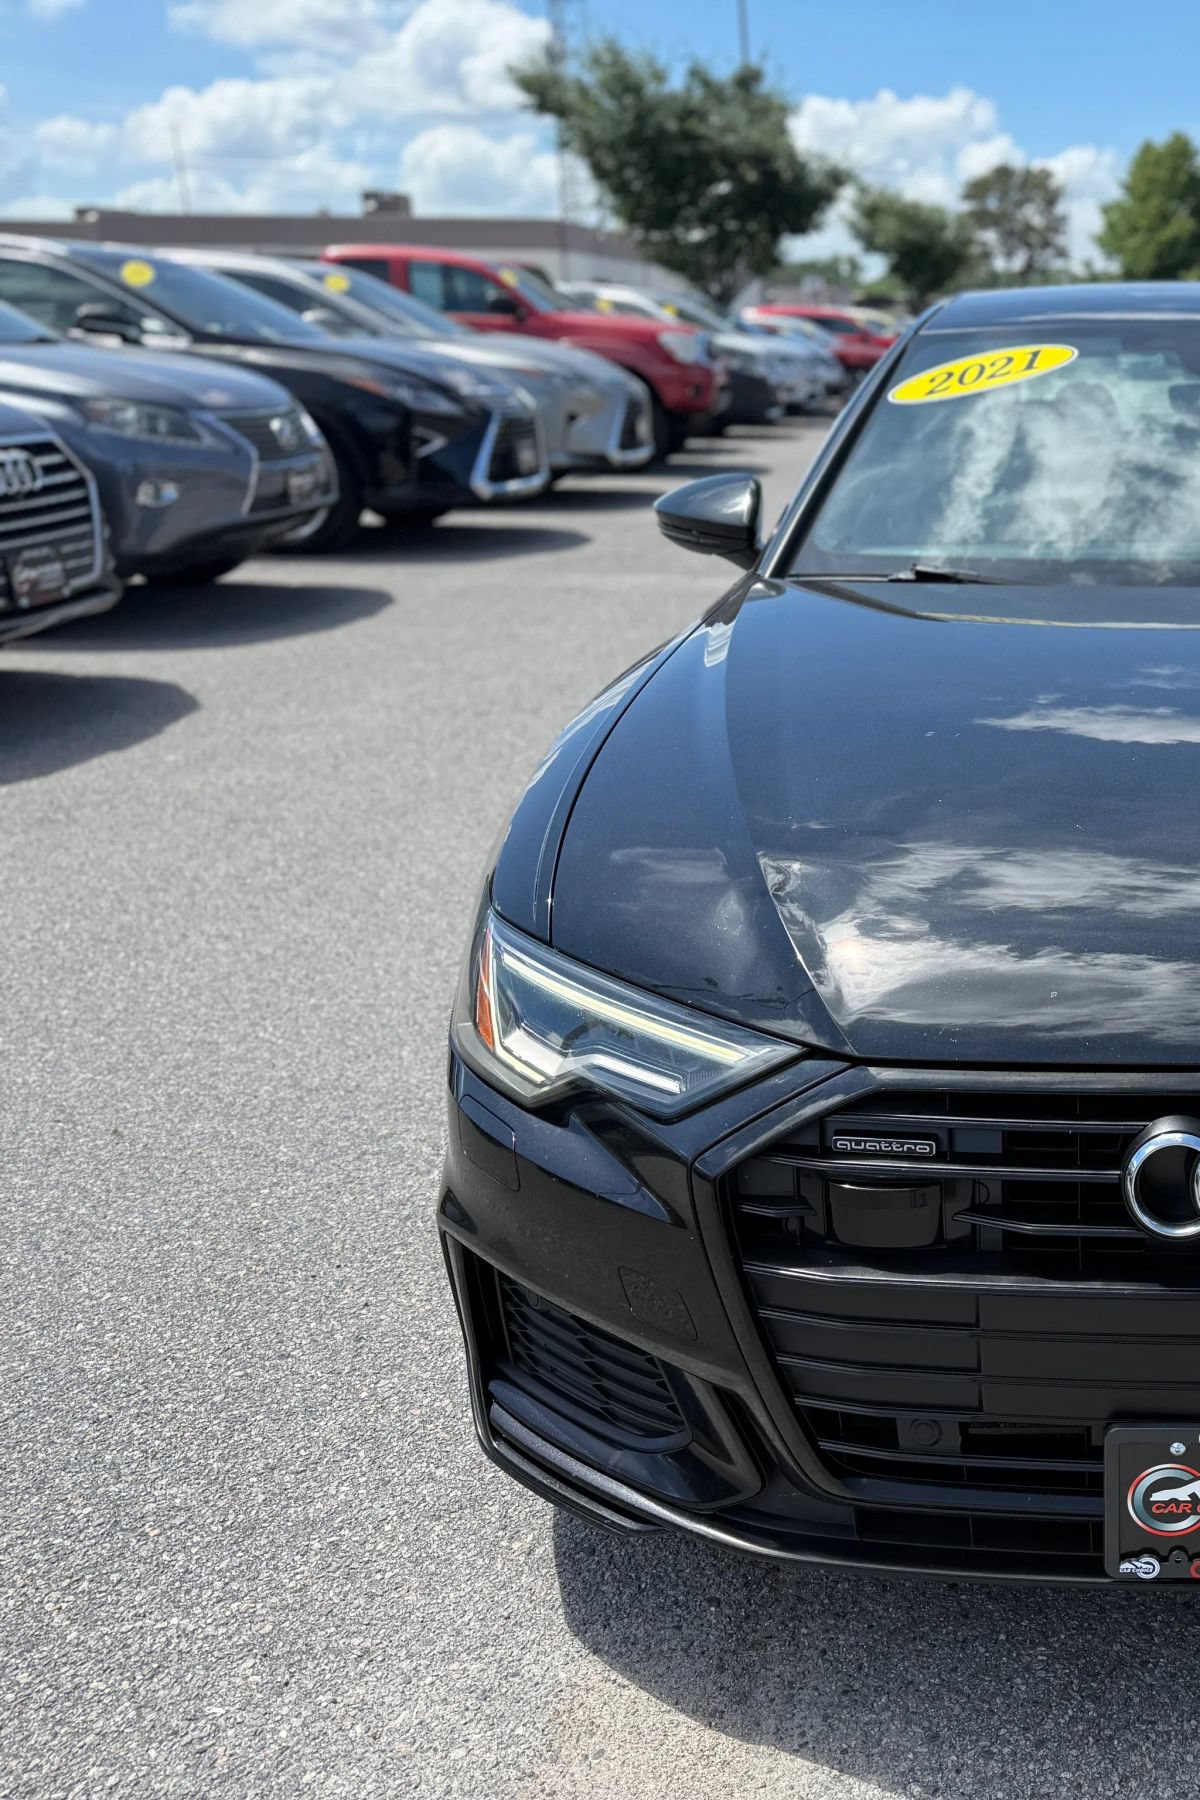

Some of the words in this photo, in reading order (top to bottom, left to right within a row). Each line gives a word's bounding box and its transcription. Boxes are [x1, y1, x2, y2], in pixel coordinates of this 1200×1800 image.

[924, 349, 1042, 397] 2021
[836, 1140, 930, 1153] quattro
[1151, 1503, 1193, 1514] CAR
